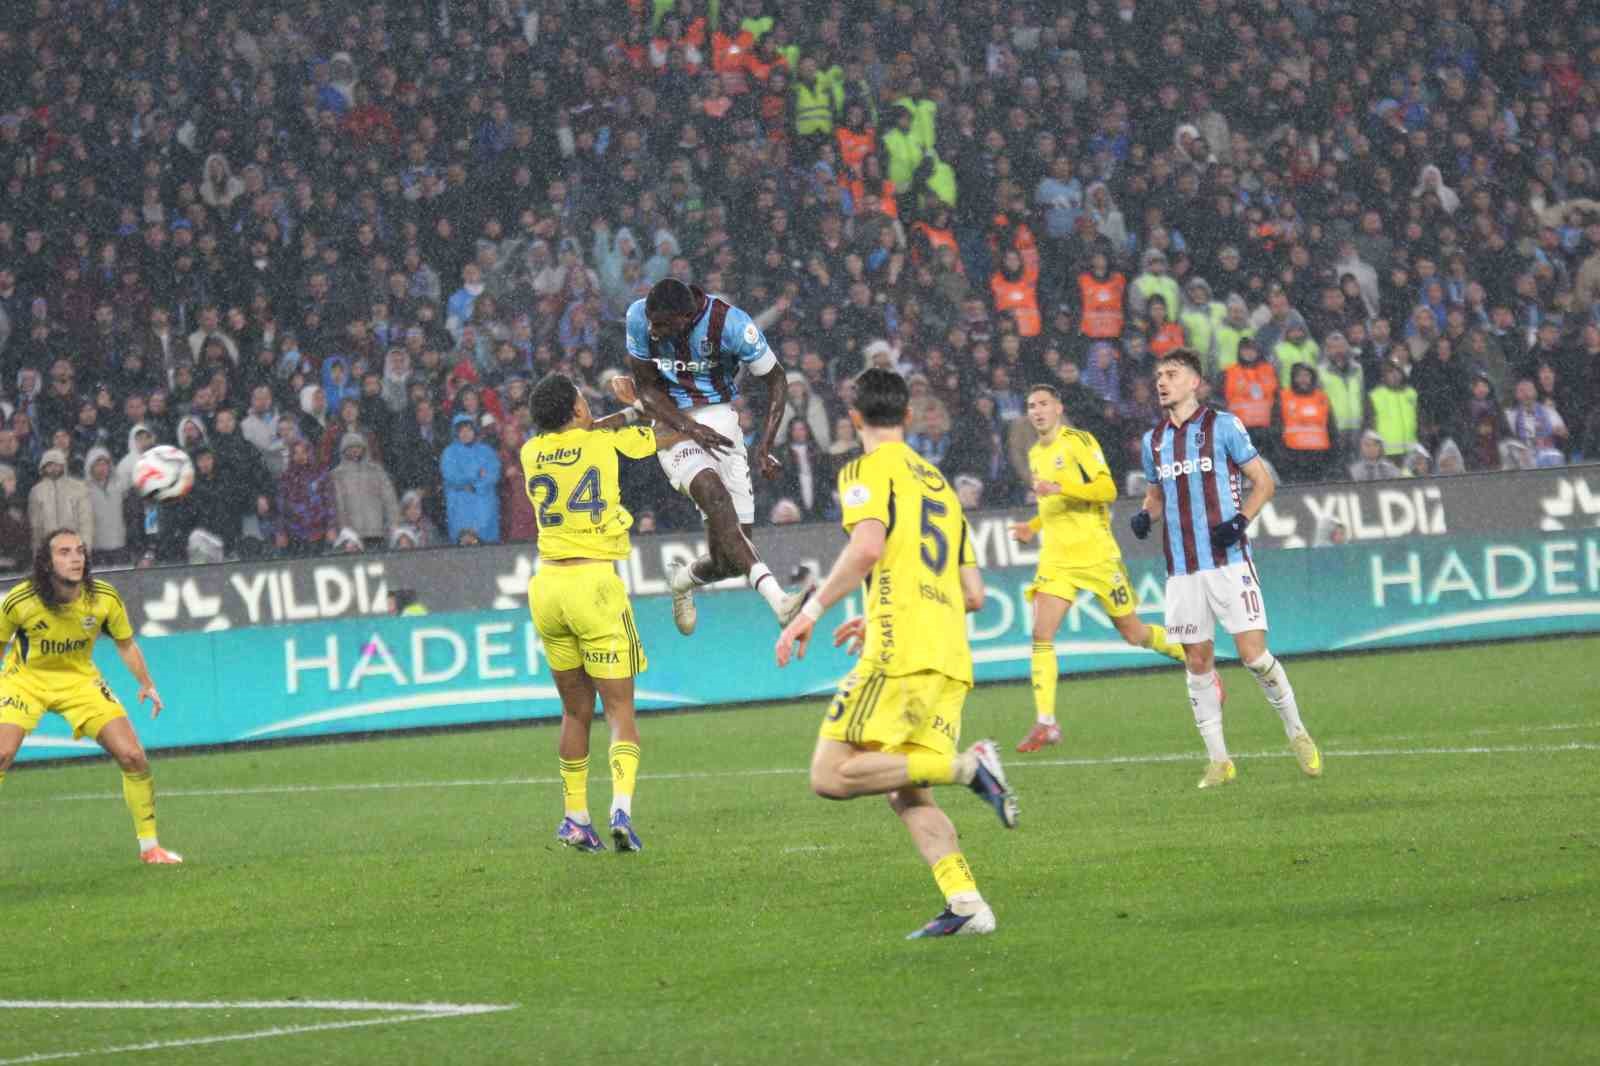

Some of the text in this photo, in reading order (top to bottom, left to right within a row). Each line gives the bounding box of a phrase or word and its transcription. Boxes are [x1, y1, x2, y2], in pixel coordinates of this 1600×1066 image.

[536, 447, 581, 466] halley
[528, 466, 608, 528] 24
[920, 494, 948, 576] 5
[1241, 590, 1260, 614] 10
[583, 650, 621, 664] ASHA
